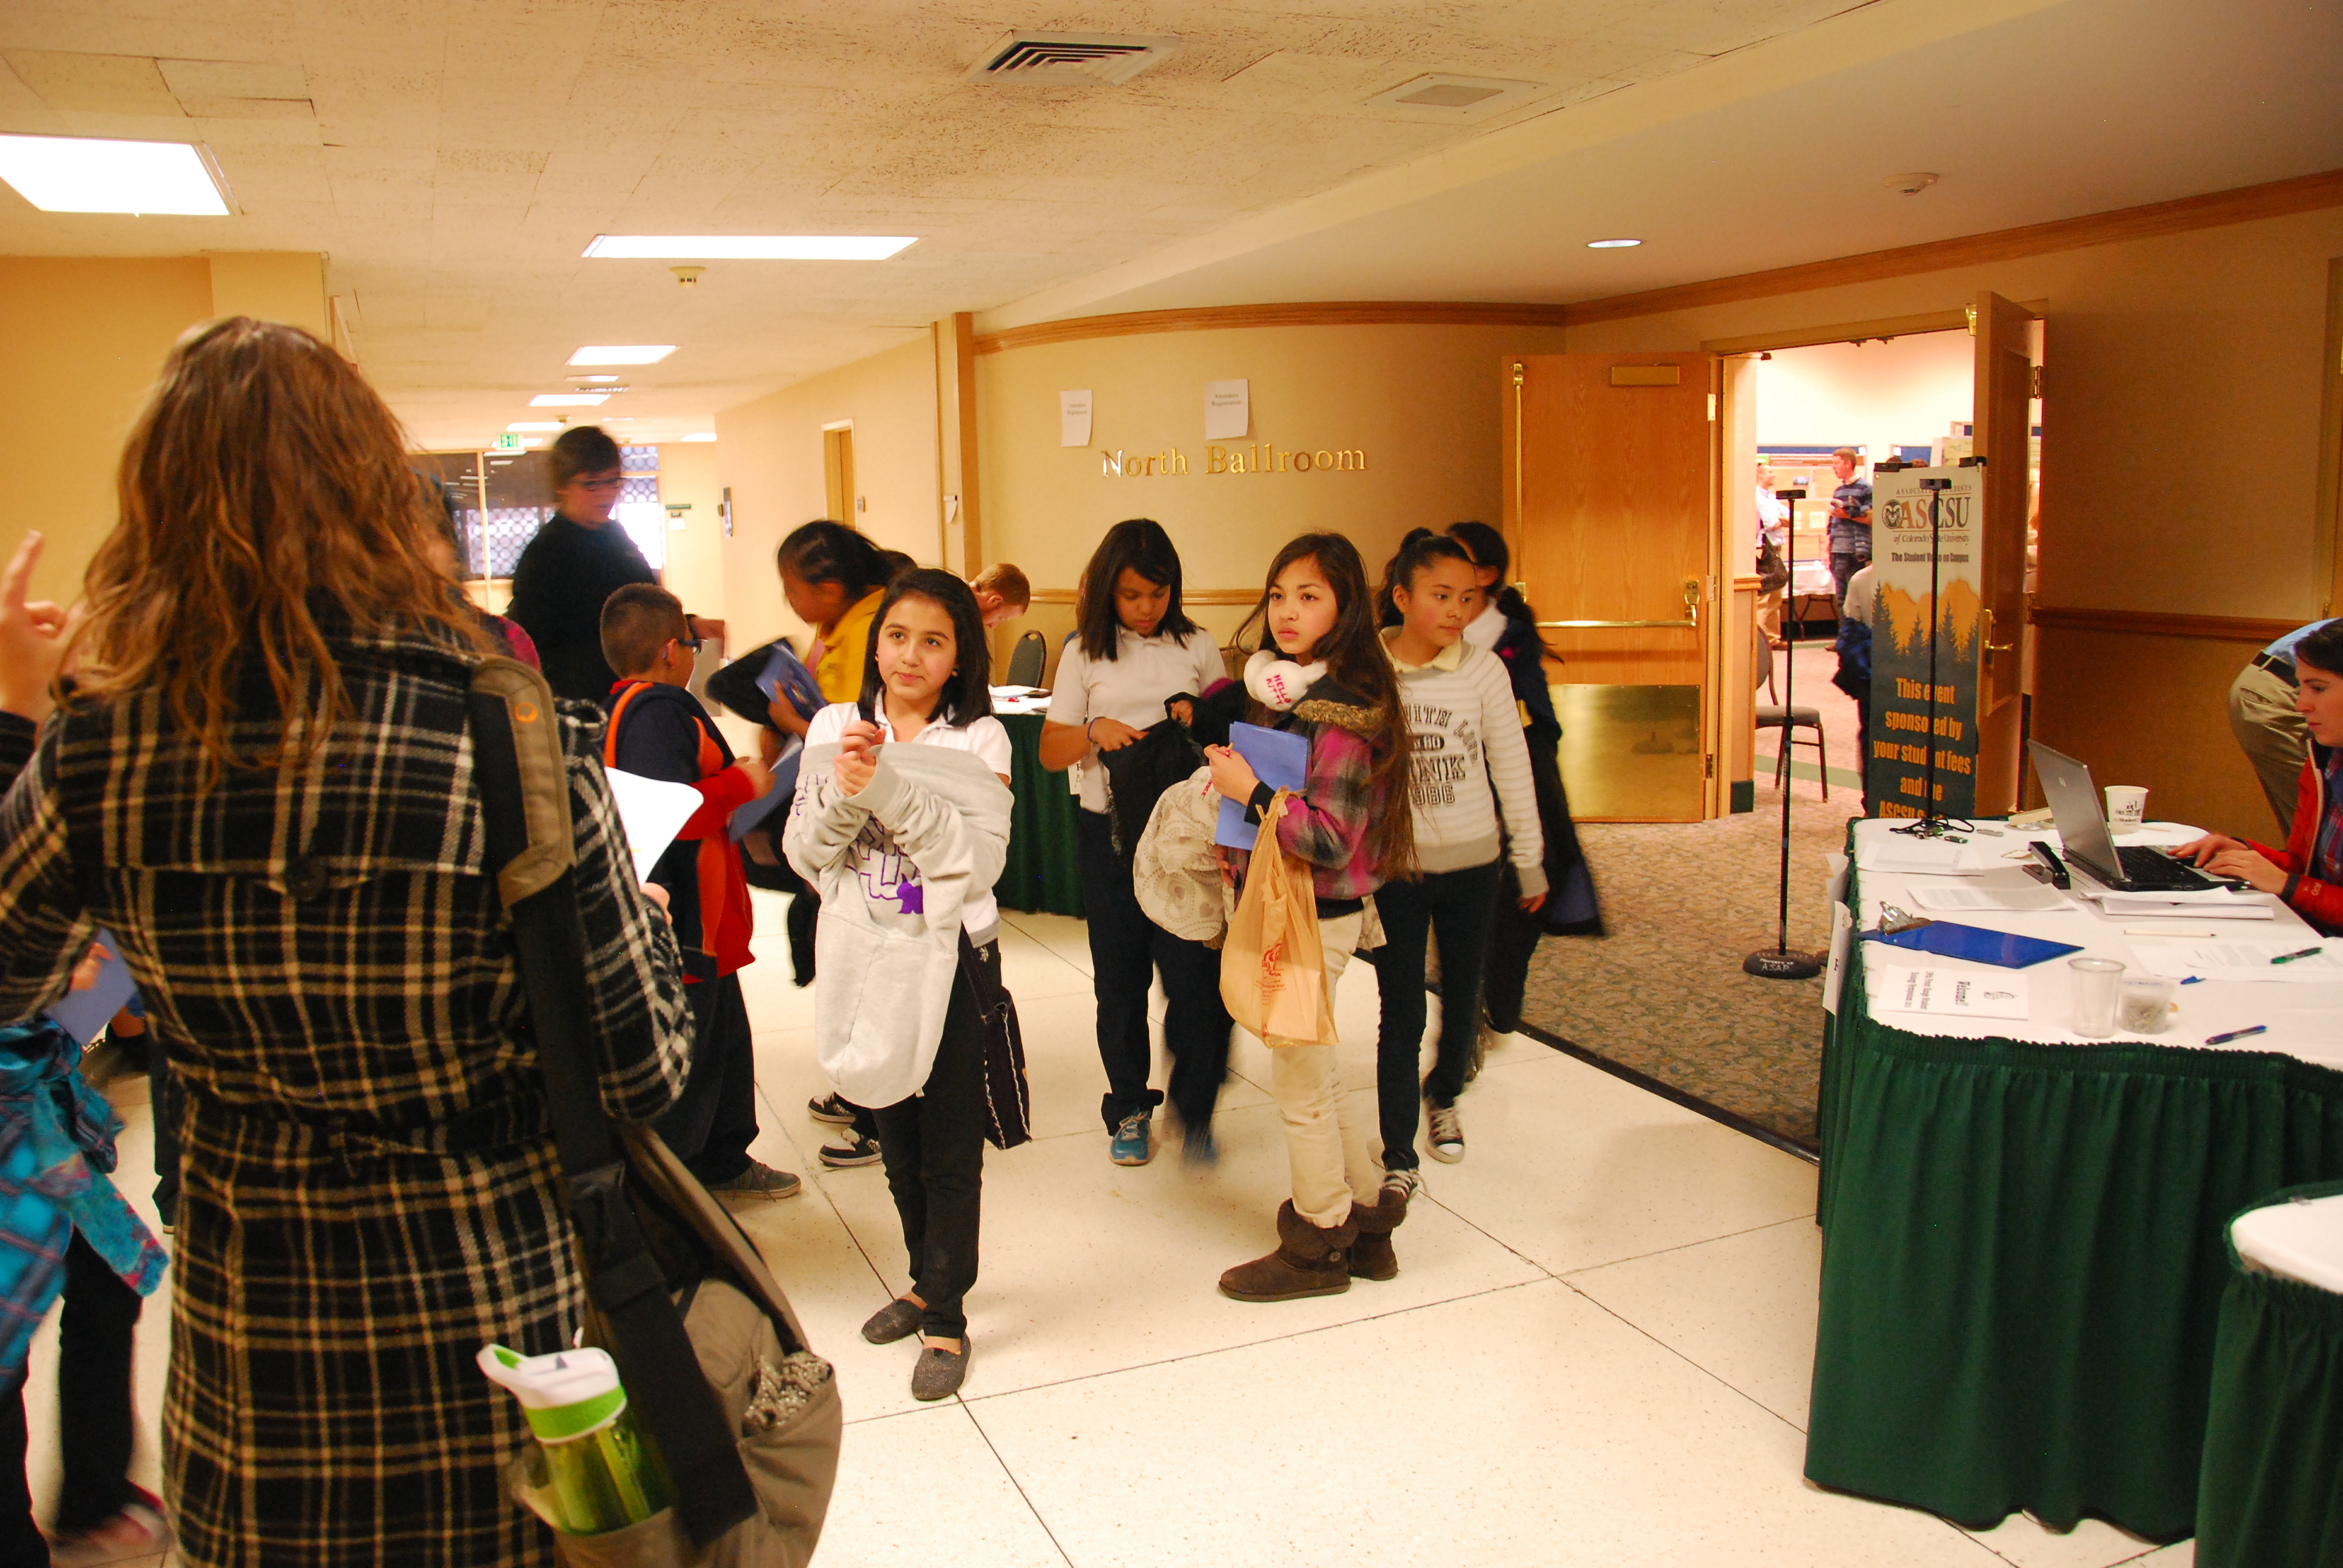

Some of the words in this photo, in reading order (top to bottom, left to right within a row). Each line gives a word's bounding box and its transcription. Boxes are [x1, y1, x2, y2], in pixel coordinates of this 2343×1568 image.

[500, 434, 519, 448] EXIT
[1101, 448, 1190, 478] North
[1205, 443, 1368, 474] Ballroom
[1899, 497, 1971, 529] ASCSU
[1893, 534, 1901, 544] of
[1892, 552, 1902, 562] The
[1904, 552, 1925, 562] Student
[1896, 678, 1922, 700] This
[1924, 684, 1955, 705] eent
[1886, 711, 1948, 737] sponsoed
[1949, 717, 1963, 741] by
[1873, 740, 1900, 760] your
[1901, 744, 1947, 769] studnt
[1947, 750, 1971, 775] fees
[1900, 777, 1924, 797] and
